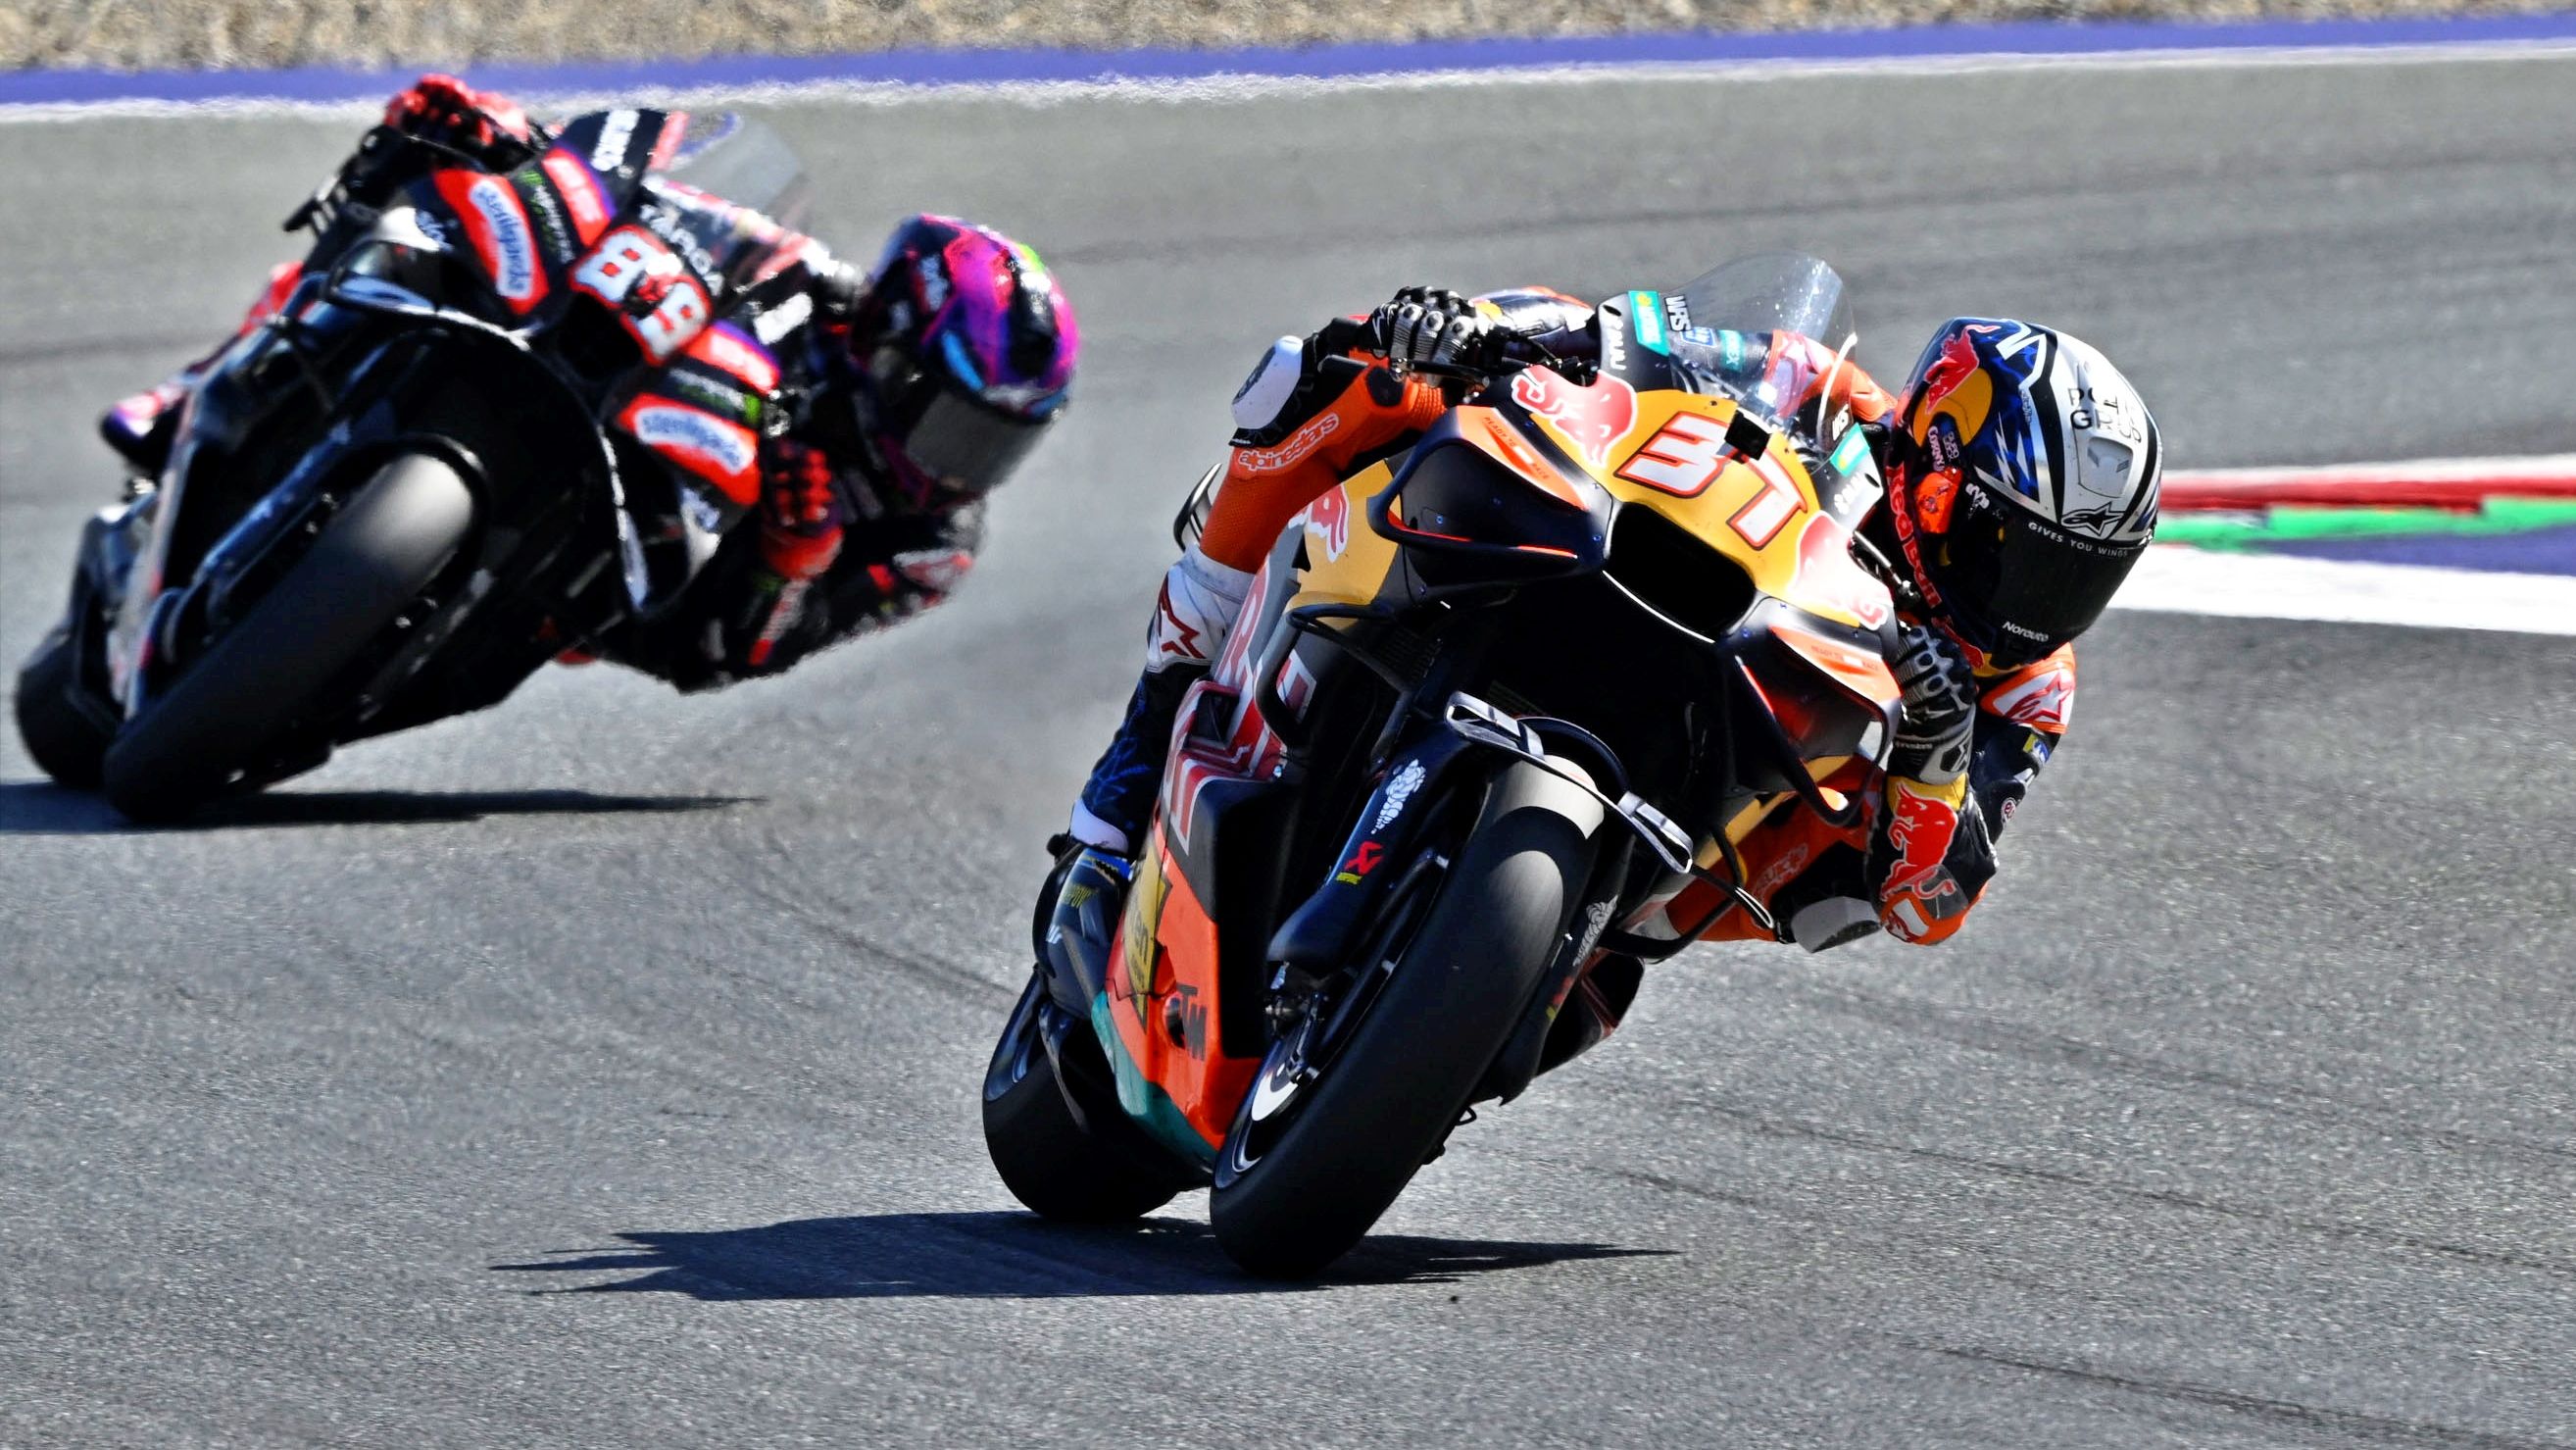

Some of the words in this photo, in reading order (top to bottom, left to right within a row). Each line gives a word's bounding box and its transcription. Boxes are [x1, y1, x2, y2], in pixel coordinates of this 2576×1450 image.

[1665, 296, 1692, 331] WRS
[1238, 412, 1339, 472] alpinestars
[1614, 411, 1808, 550] 37
[2028, 522, 2064, 543] GIVES
[2069, 539, 2093, 552] YOU
[2098, 546, 2128, 557] WINGS
